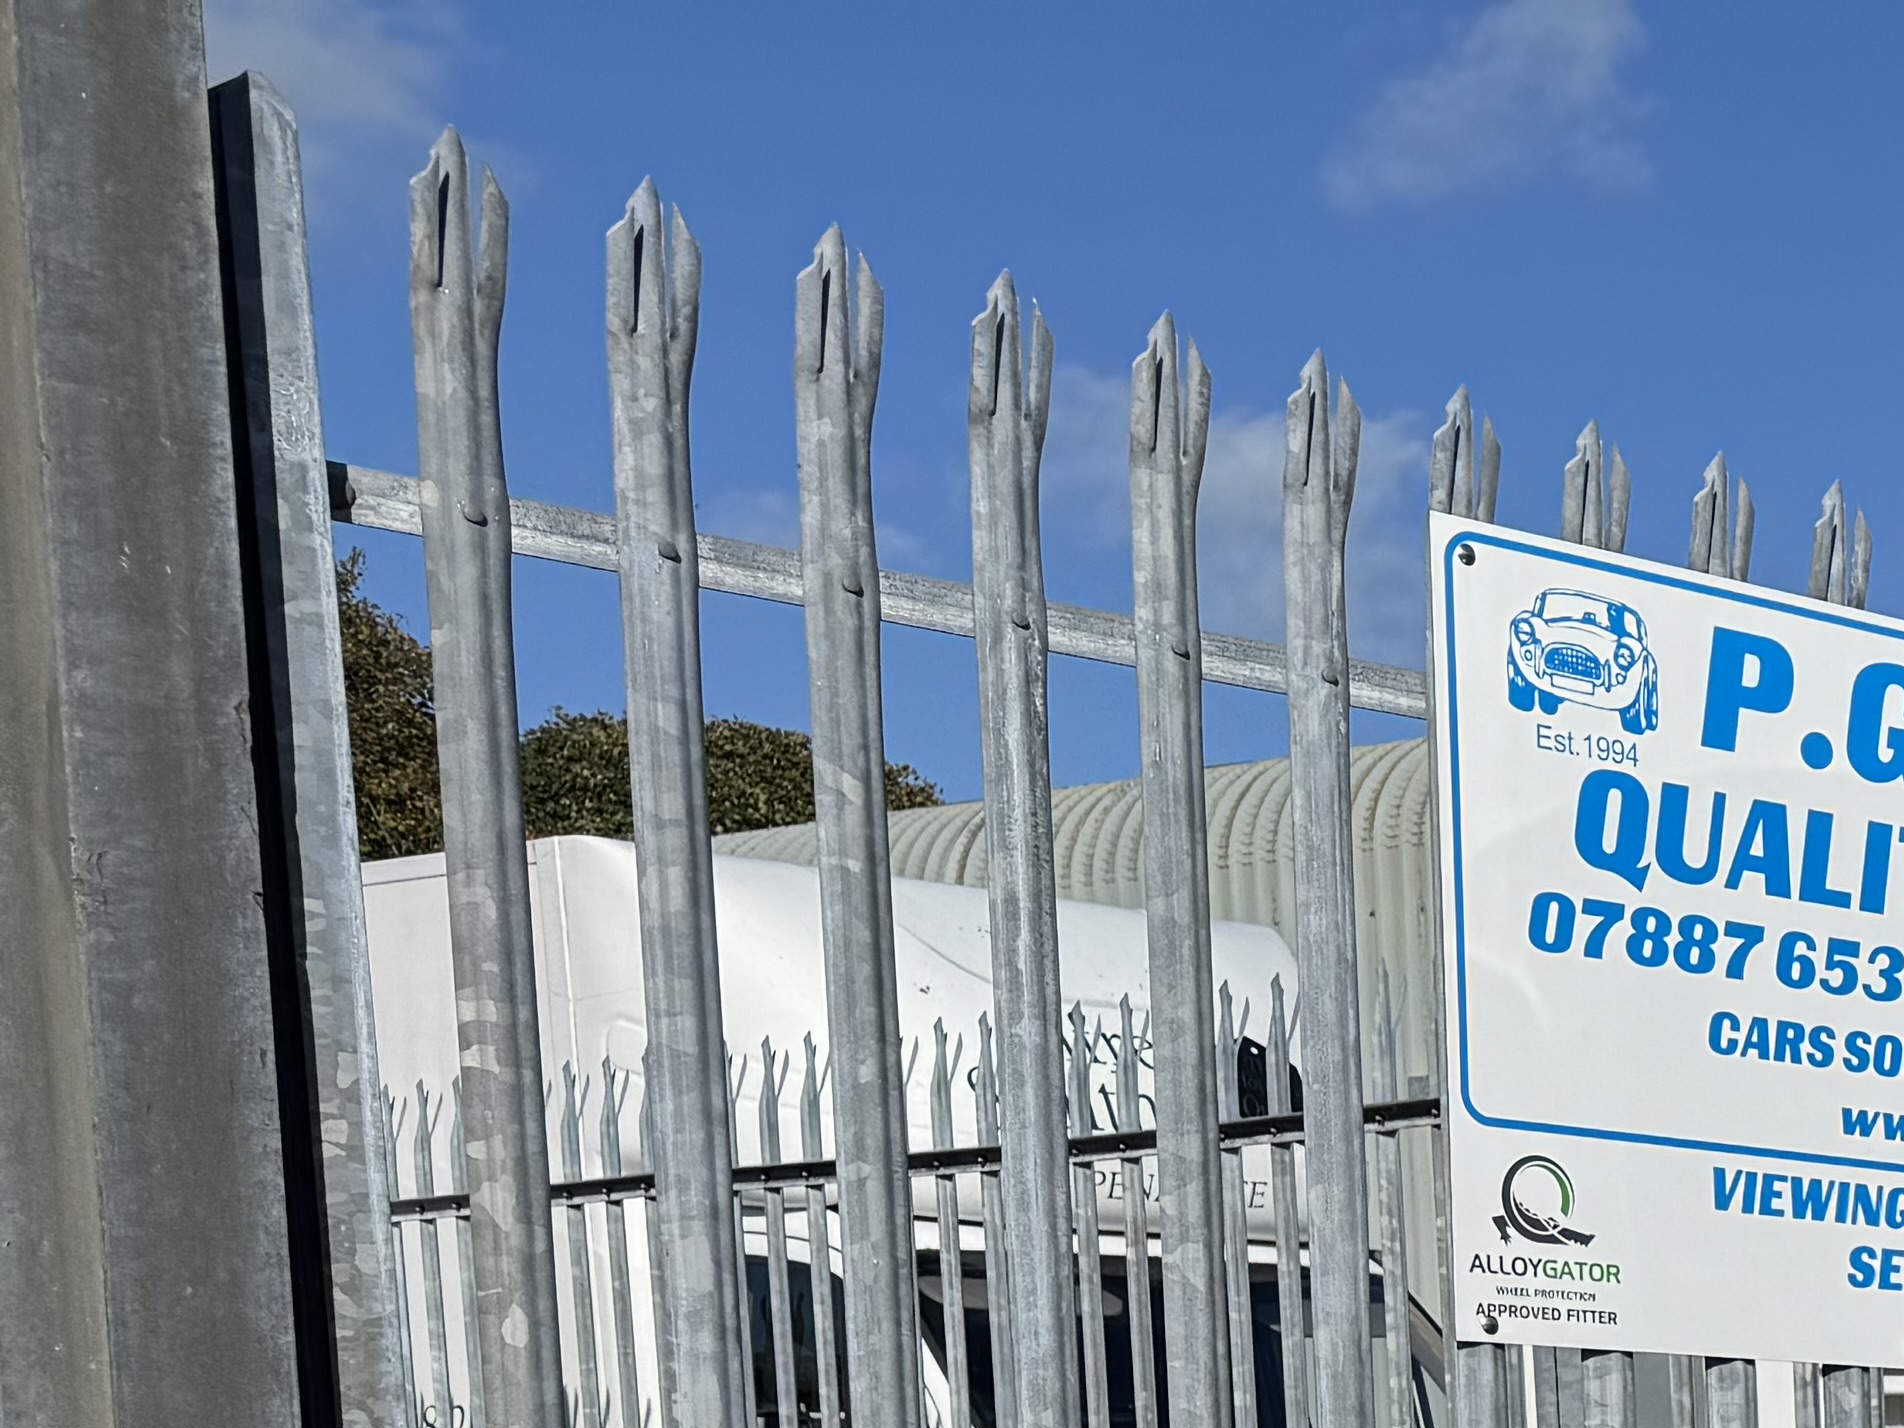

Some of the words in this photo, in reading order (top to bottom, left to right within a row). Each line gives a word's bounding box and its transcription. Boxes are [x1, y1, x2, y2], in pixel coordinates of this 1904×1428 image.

[1536, 723, 1639, 767] Est.1994
[1529, 892, 1765, 980] 07887
[1776, 931, 1904, 1002] 653
[1709, 1012, 1836, 1068] CARS
[1469, 1254, 1621, 1284] ALLOYGATOR
[1476, 1302, 1561, 1321] APPROVED
[1567, 1309, 1618, 1325] FITTER
